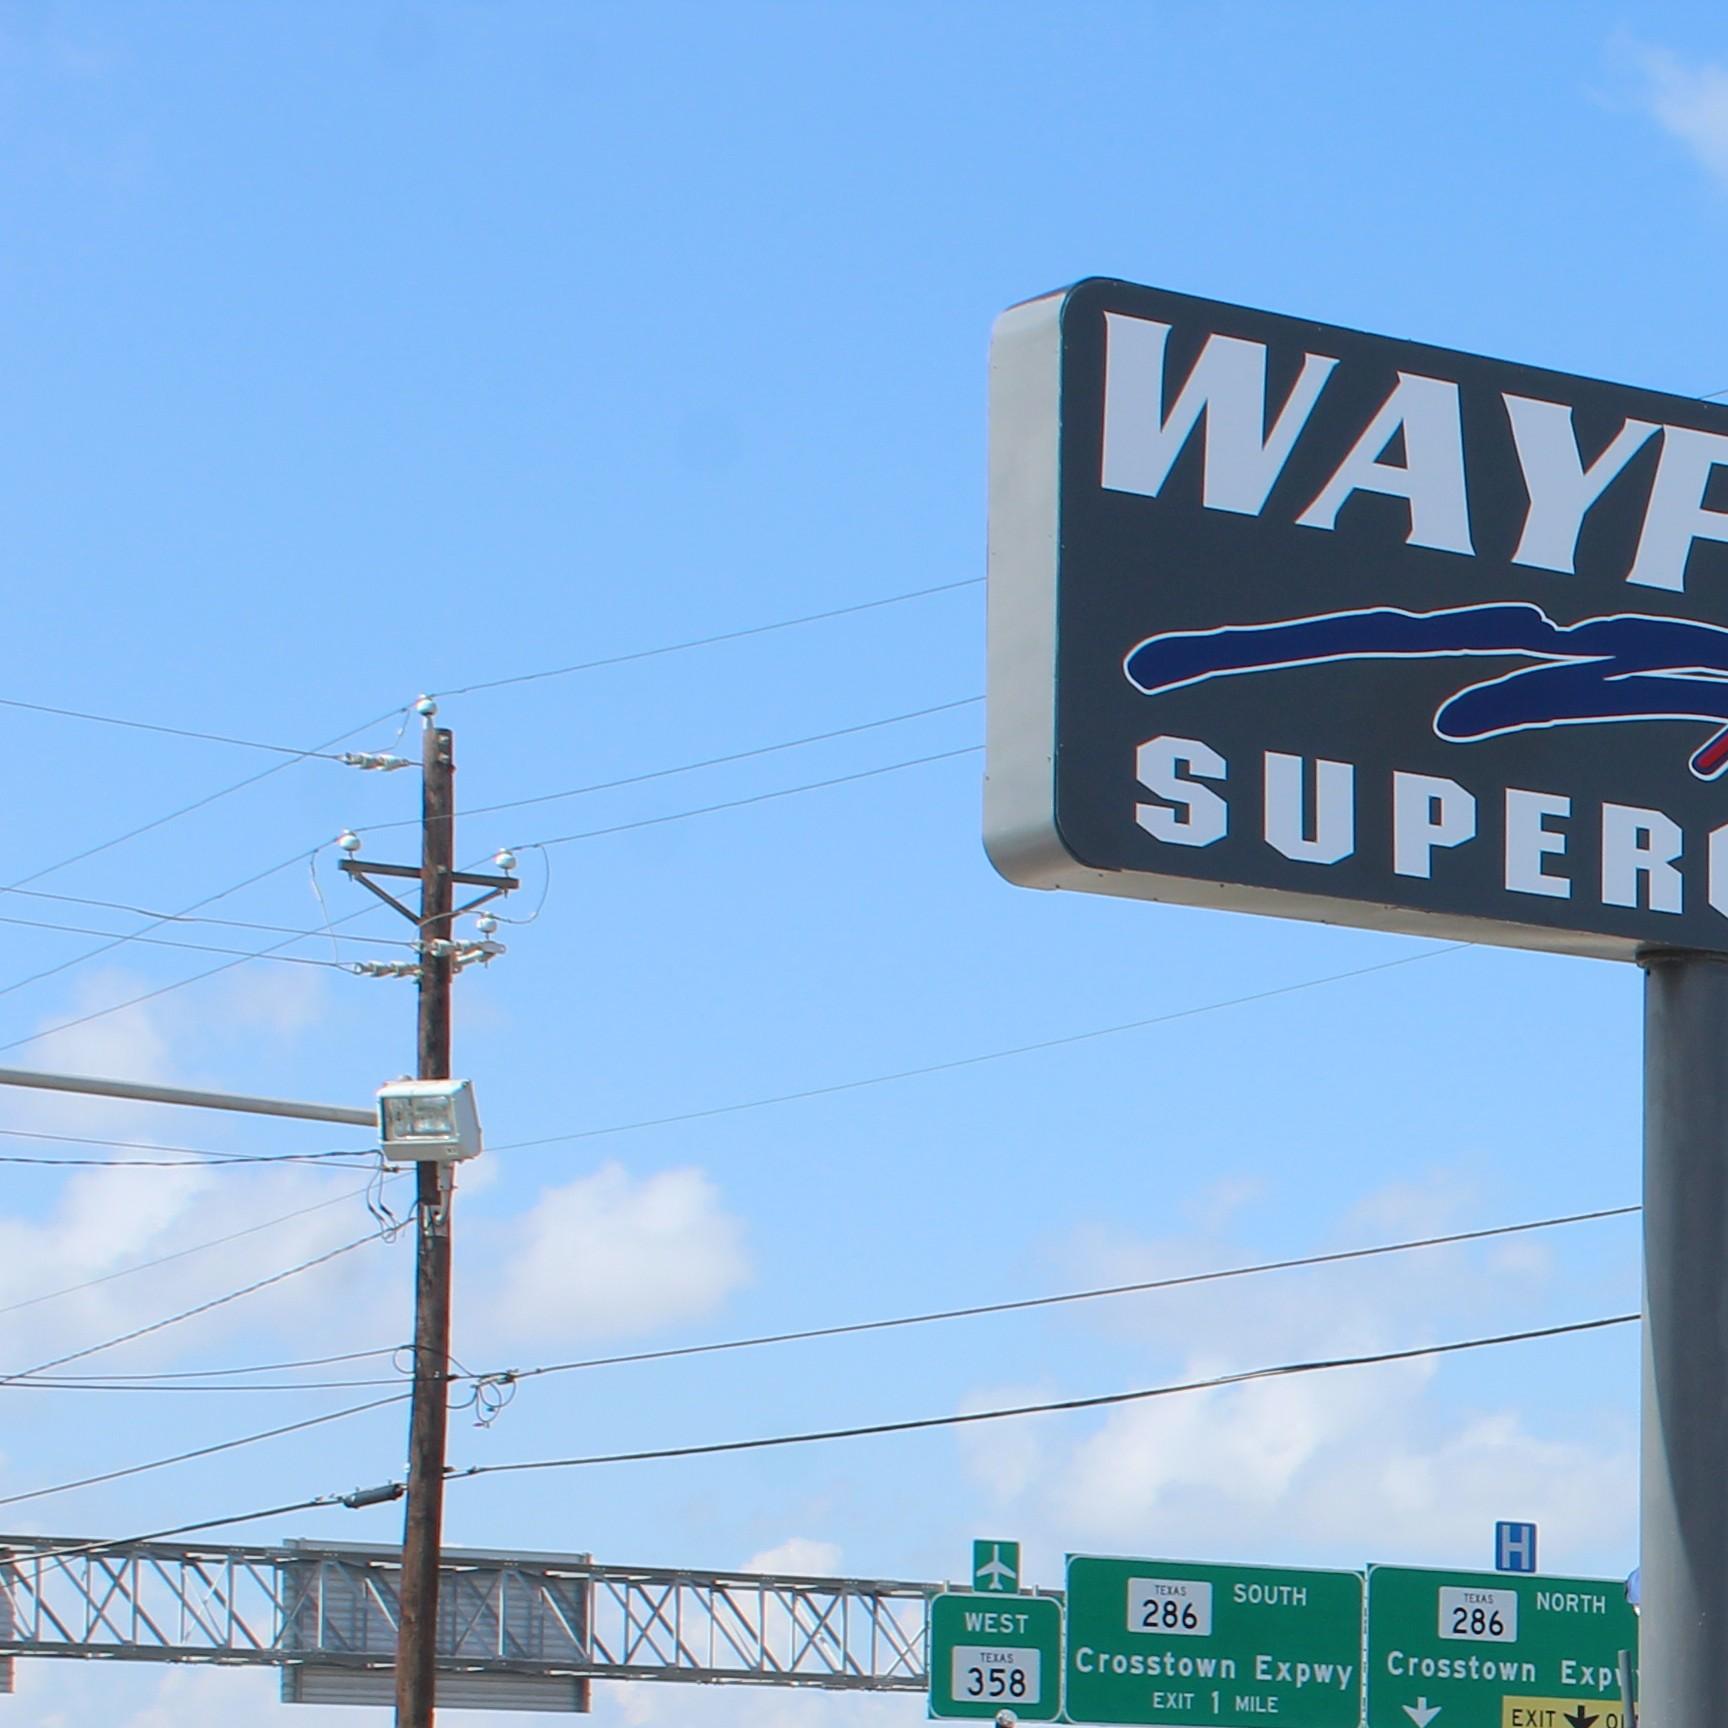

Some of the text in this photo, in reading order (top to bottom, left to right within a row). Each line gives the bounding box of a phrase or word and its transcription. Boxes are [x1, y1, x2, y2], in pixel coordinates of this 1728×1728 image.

[1501, 1525, 1530, 1570] H
[1154, 1584, 1187, 1597] TEXAS
[1233, 1583, 1307, 1607] SOUTH
[1464, 1592, 1494, 1605] TEXAS
[1536, 1591, 1606, 1614] NORTH
[965, 1612, 1029, 1634] WEST
[1142, 1600, 1198, 1630] 286
[1452, 1607, 1504, 1636] 286
[980, 1652, 1014, 1664] TEXAS
[1075, 1646, 1353, 1690] Crosstown Expwy
[967, 1667, 1027, 1698] 358
[1387, 1650, 1640, 1692] Crosstown Exp
[1153, 1690, 1279, 1714] EXIT 1 MILE
[1512, 1708, 1556, 1728] EXIT
